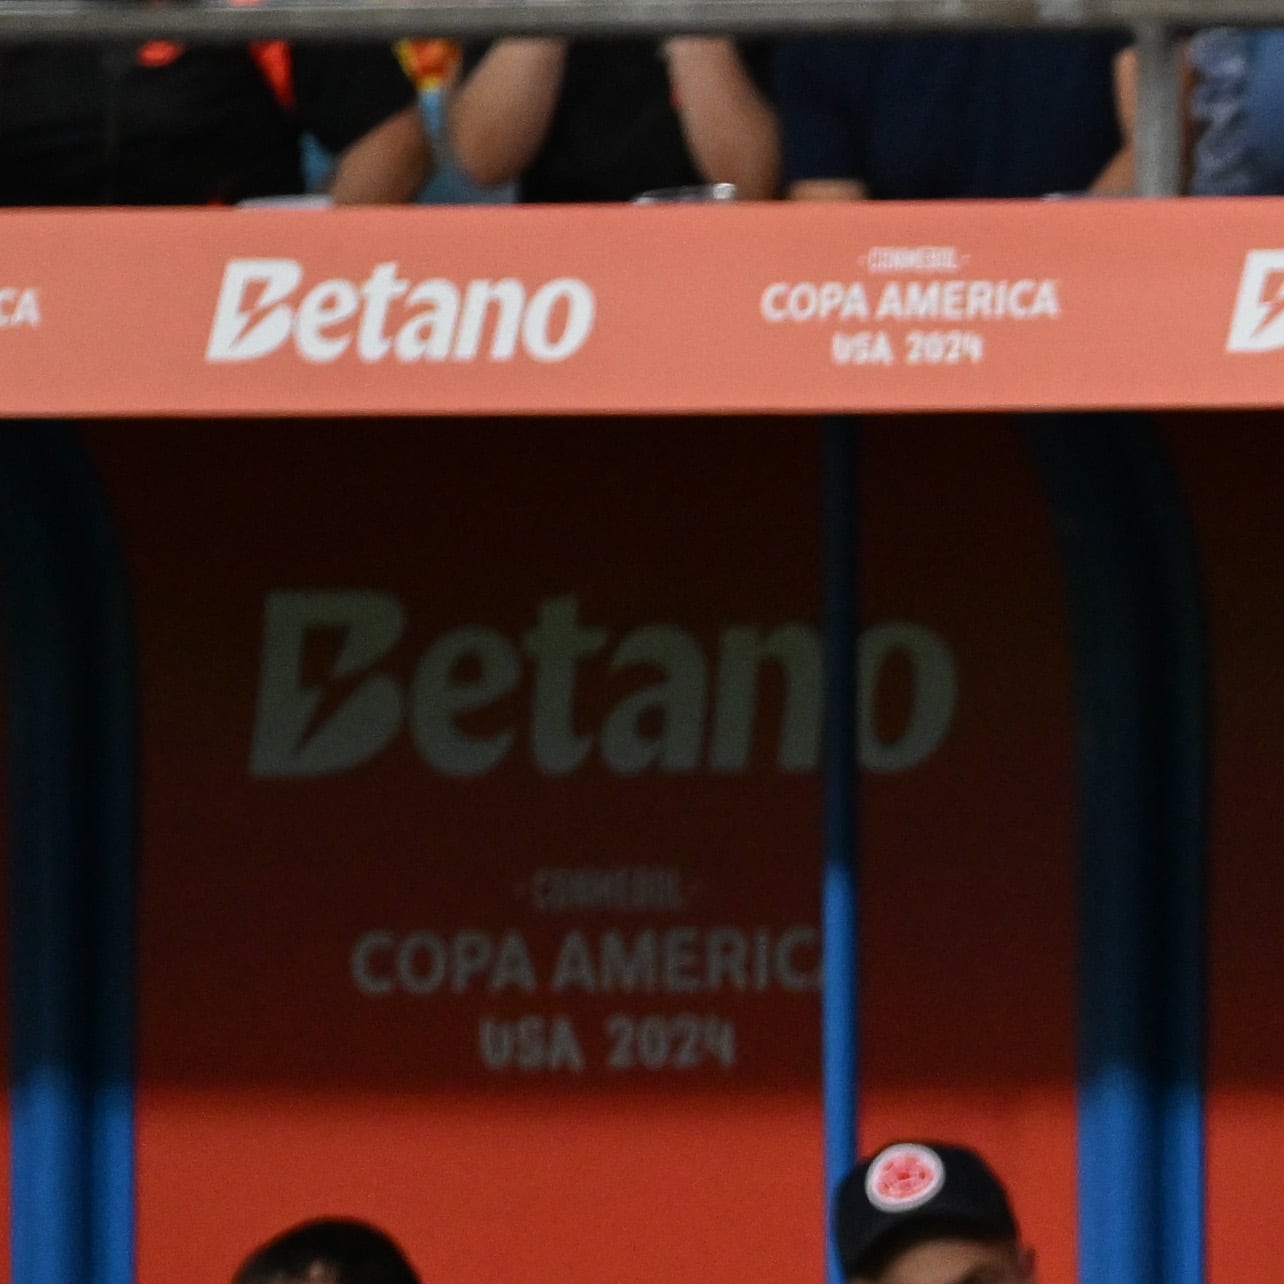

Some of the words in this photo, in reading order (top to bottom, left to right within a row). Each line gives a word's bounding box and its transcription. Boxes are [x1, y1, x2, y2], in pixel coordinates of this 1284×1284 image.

[205, 258, 596, 365] Betano
[761, 282, 868, 322] COPA
[874, 279, 1060, 320] AMERICA
[832, 332, 894, 364] USA
[905, 330, 983, 365] 2024
[249, 589, 958, 777] Betano
[350, 930, 537, 997] COPA
[550, 925, 823, 995] AMERIC
[479, 1019, 582, 1073] USA
[604, 1017, 736, 1070] 2024
